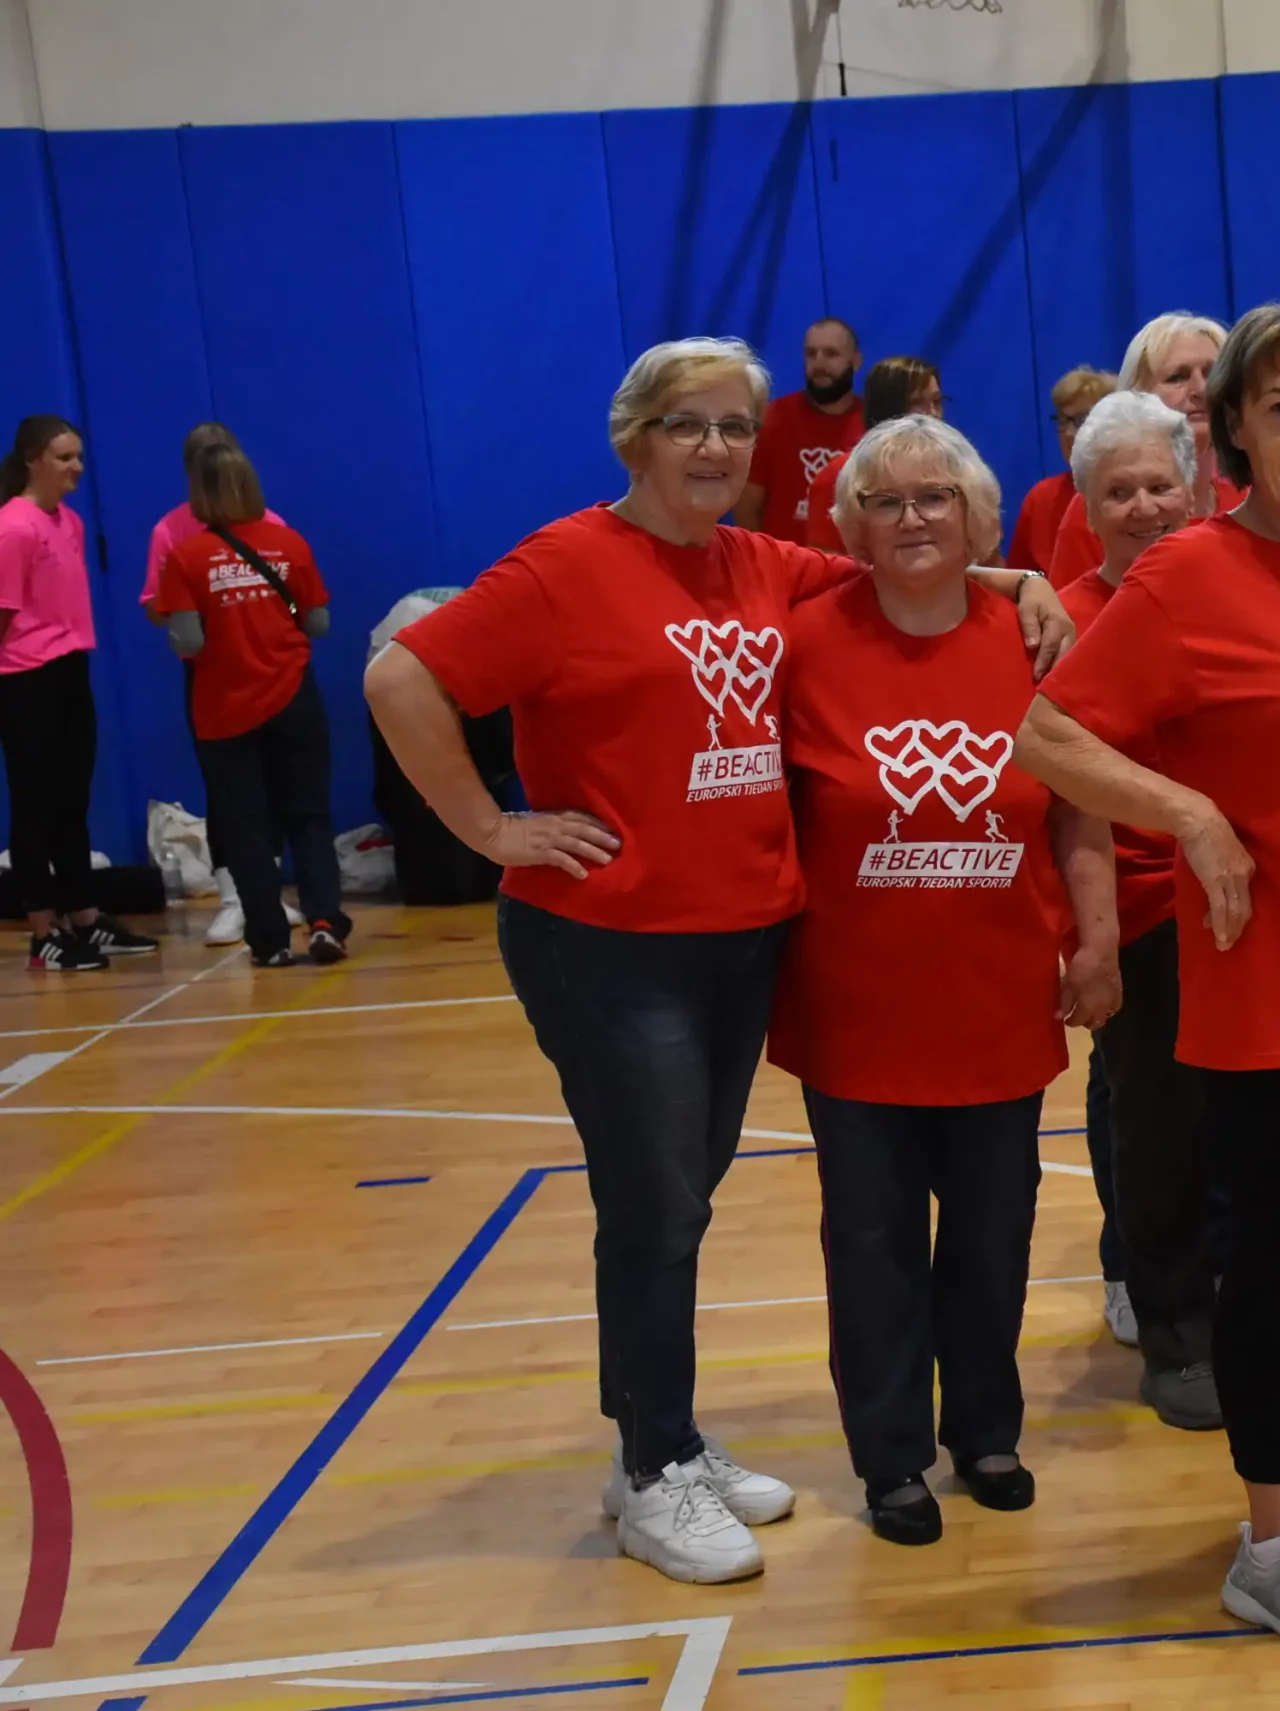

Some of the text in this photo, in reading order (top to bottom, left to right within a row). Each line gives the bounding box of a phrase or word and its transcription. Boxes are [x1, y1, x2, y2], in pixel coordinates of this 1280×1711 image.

[697, 750, 781, 782] #BEACTIV
[686, 785, 742, 803] EUROPSKI
[744, 781, 773, 796] TJEDAN
[869, 848, 1017, 871] #BEACTIVE
[855, 876, 1012, 889] EUROPSKI TJEDAN SPORTA
